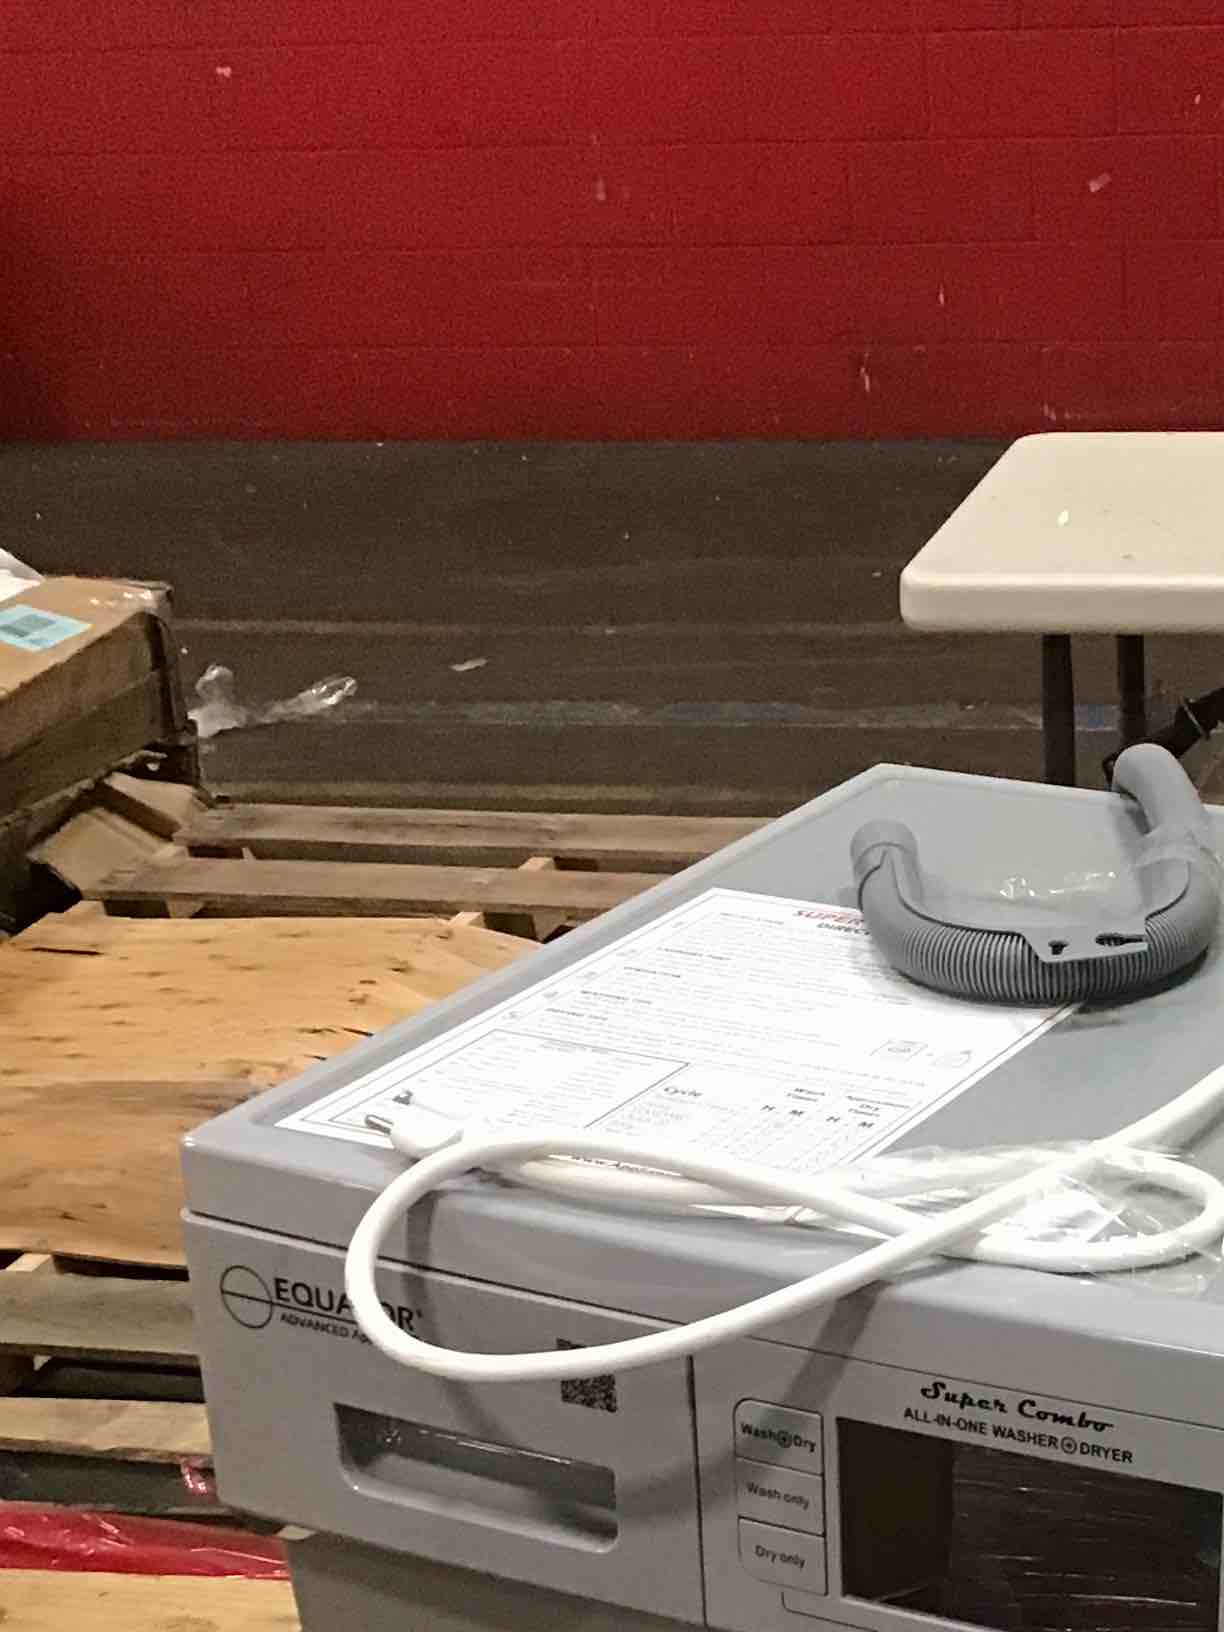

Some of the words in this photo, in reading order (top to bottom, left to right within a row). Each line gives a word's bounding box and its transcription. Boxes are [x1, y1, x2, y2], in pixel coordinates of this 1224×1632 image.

[274, 1277, 415, 1331] EQUAOR
[279, 1313, 349, 1338] ADVANCED
[920, 1381, 1009, 1414] Super
[1017, 1398, 1114, 1432] Combo
[793, 1435, 816, 1453] Dry
[903, 1407, 988, 1436] ALL-IN-ONE
[992, 1424, 1059, 1451] WASHER
[1079, 1442, 1134, 1464] DRYER
[747, 1481, 781, 1500] Wash
[783, 1492, 809, 1510] only
[755, 1545, 778, 1564] Dry
[779, 1552, 806, 1569] only
